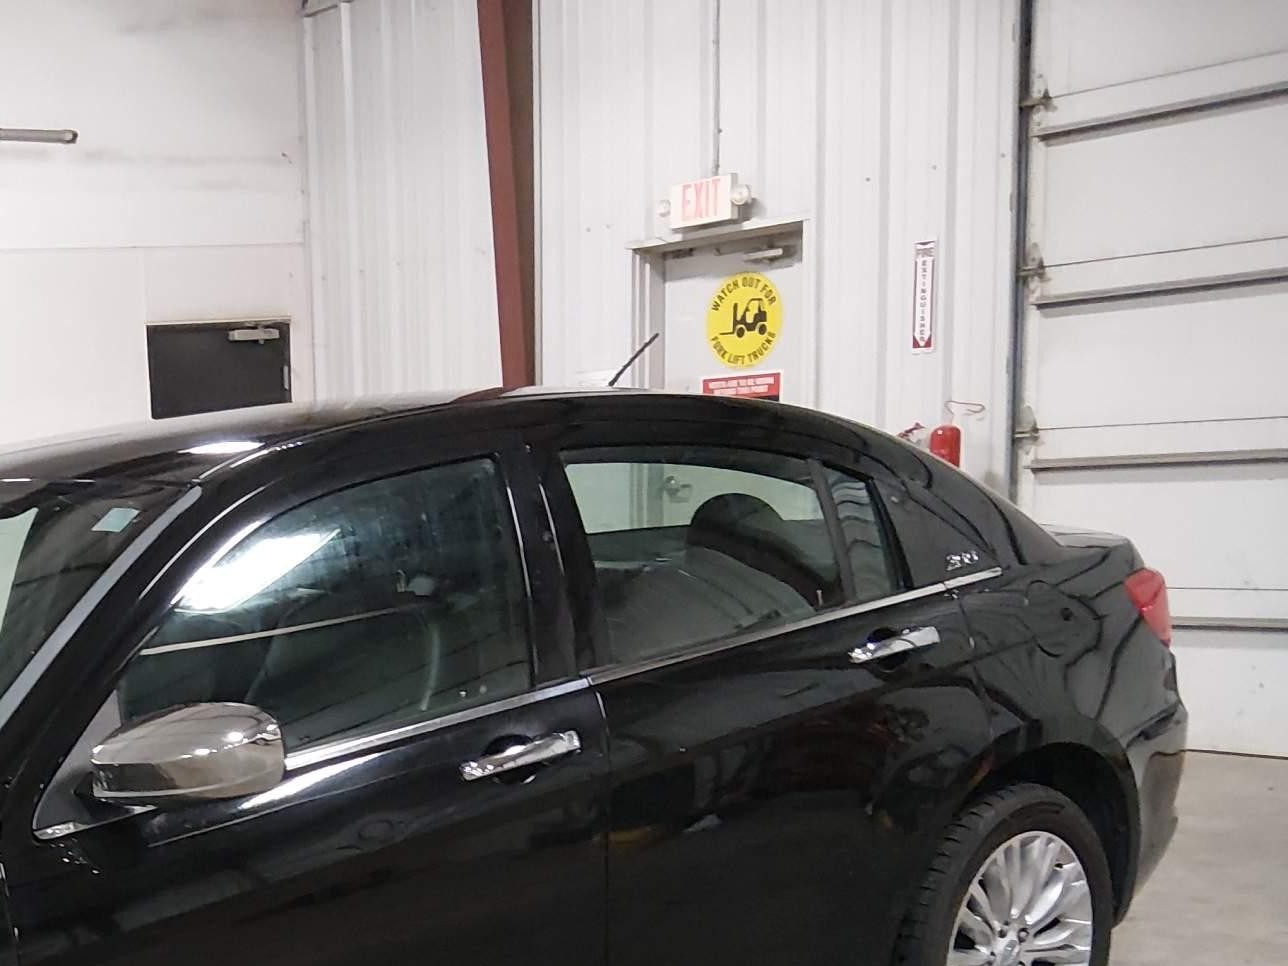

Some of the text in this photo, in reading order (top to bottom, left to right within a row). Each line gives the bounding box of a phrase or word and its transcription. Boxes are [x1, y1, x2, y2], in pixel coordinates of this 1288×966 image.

[682, 179, 721, 222] EXIT
[712, 277, 777, 311] WATCH OUT FOR
[711, 331, 776, 364] FORK LIFT TRUCKS
